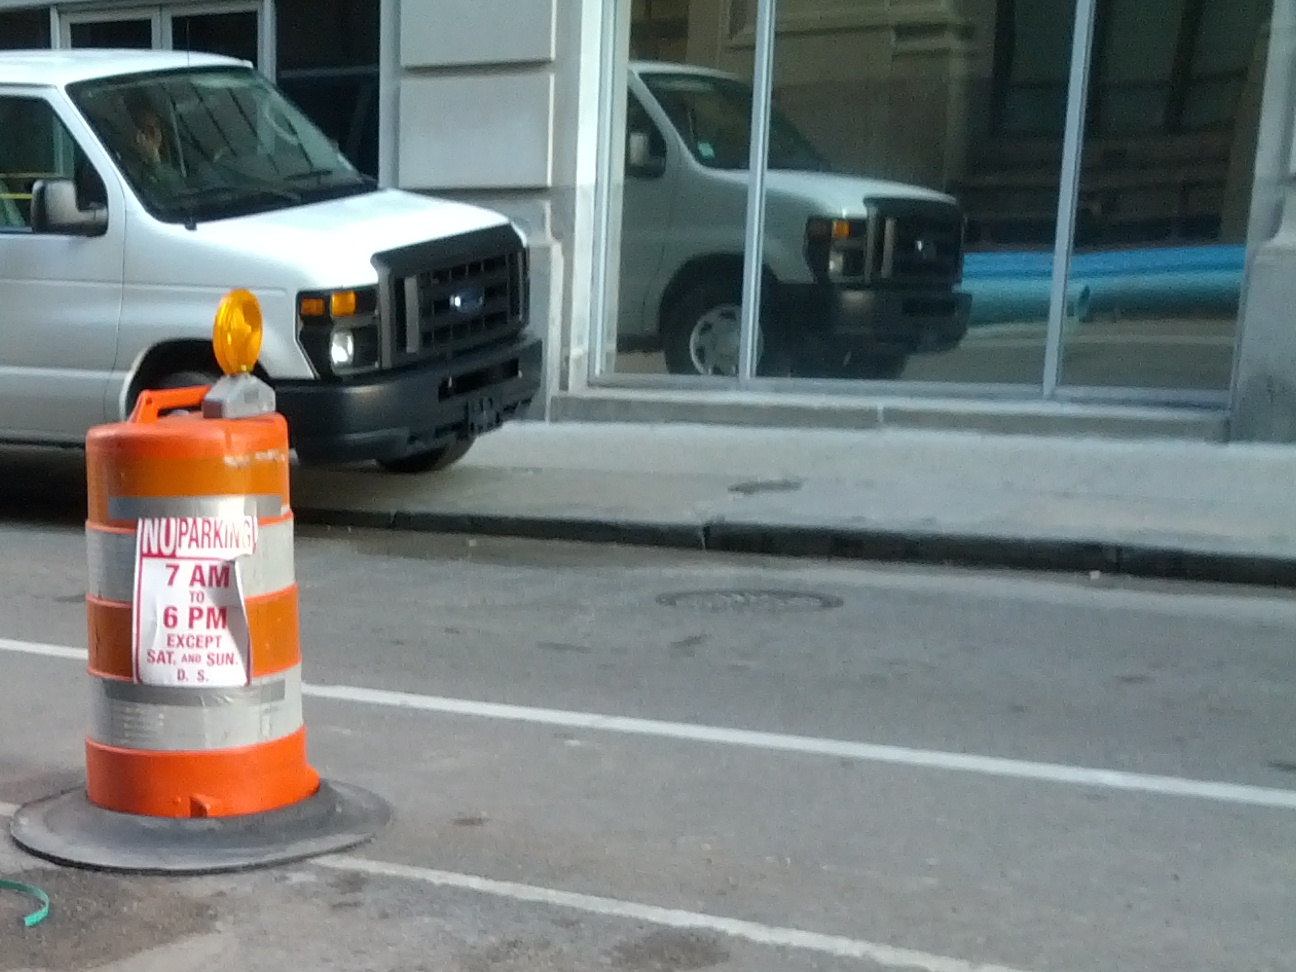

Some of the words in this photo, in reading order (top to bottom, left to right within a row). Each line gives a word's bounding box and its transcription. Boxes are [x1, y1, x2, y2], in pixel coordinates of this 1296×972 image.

[143, 517, 176, 555] NO
[177, 517, 251, 549] PARKING
[165, 564, 180, 587] 7
[189, 565, 230, 588] AM
[189, 590, 205, 604] TO
[163, 606, 178, 629] 6
[188, 606, 227, 630] PM
[167, 633, 223, 649] EXCEPT
[181, 654, 202, 664] AND
[206, 653, 239, 667] SUN.
[177, 668, 189, 682] D.
[197, 669, 209, 683] S.
